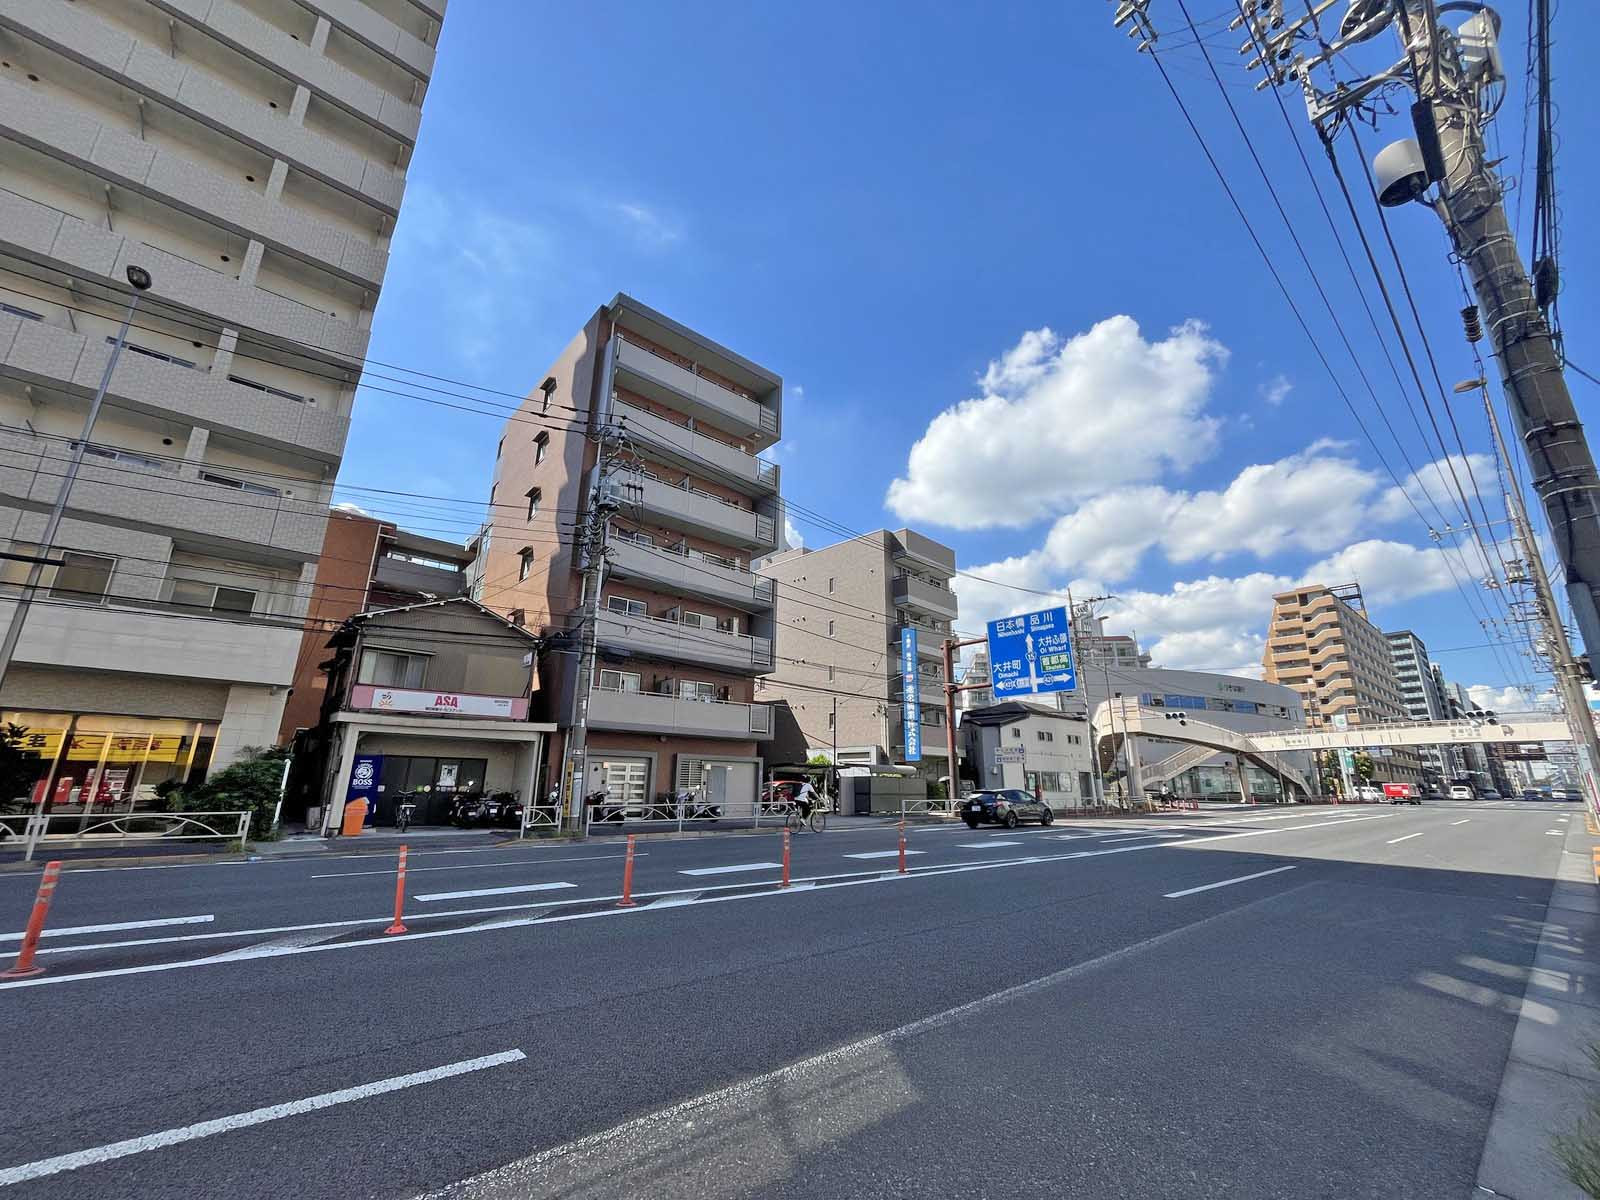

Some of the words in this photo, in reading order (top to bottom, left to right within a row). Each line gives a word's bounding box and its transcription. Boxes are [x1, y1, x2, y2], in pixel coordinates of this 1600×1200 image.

[996, 617, 1024, 632] 日本橋
[1030, 611, 1053, 626] 品川
[1038, 632, 1068, 648] 大井ふ頭
[434, 695, 458, 708] ASA
[353, 778, 373, 786] BOSS
